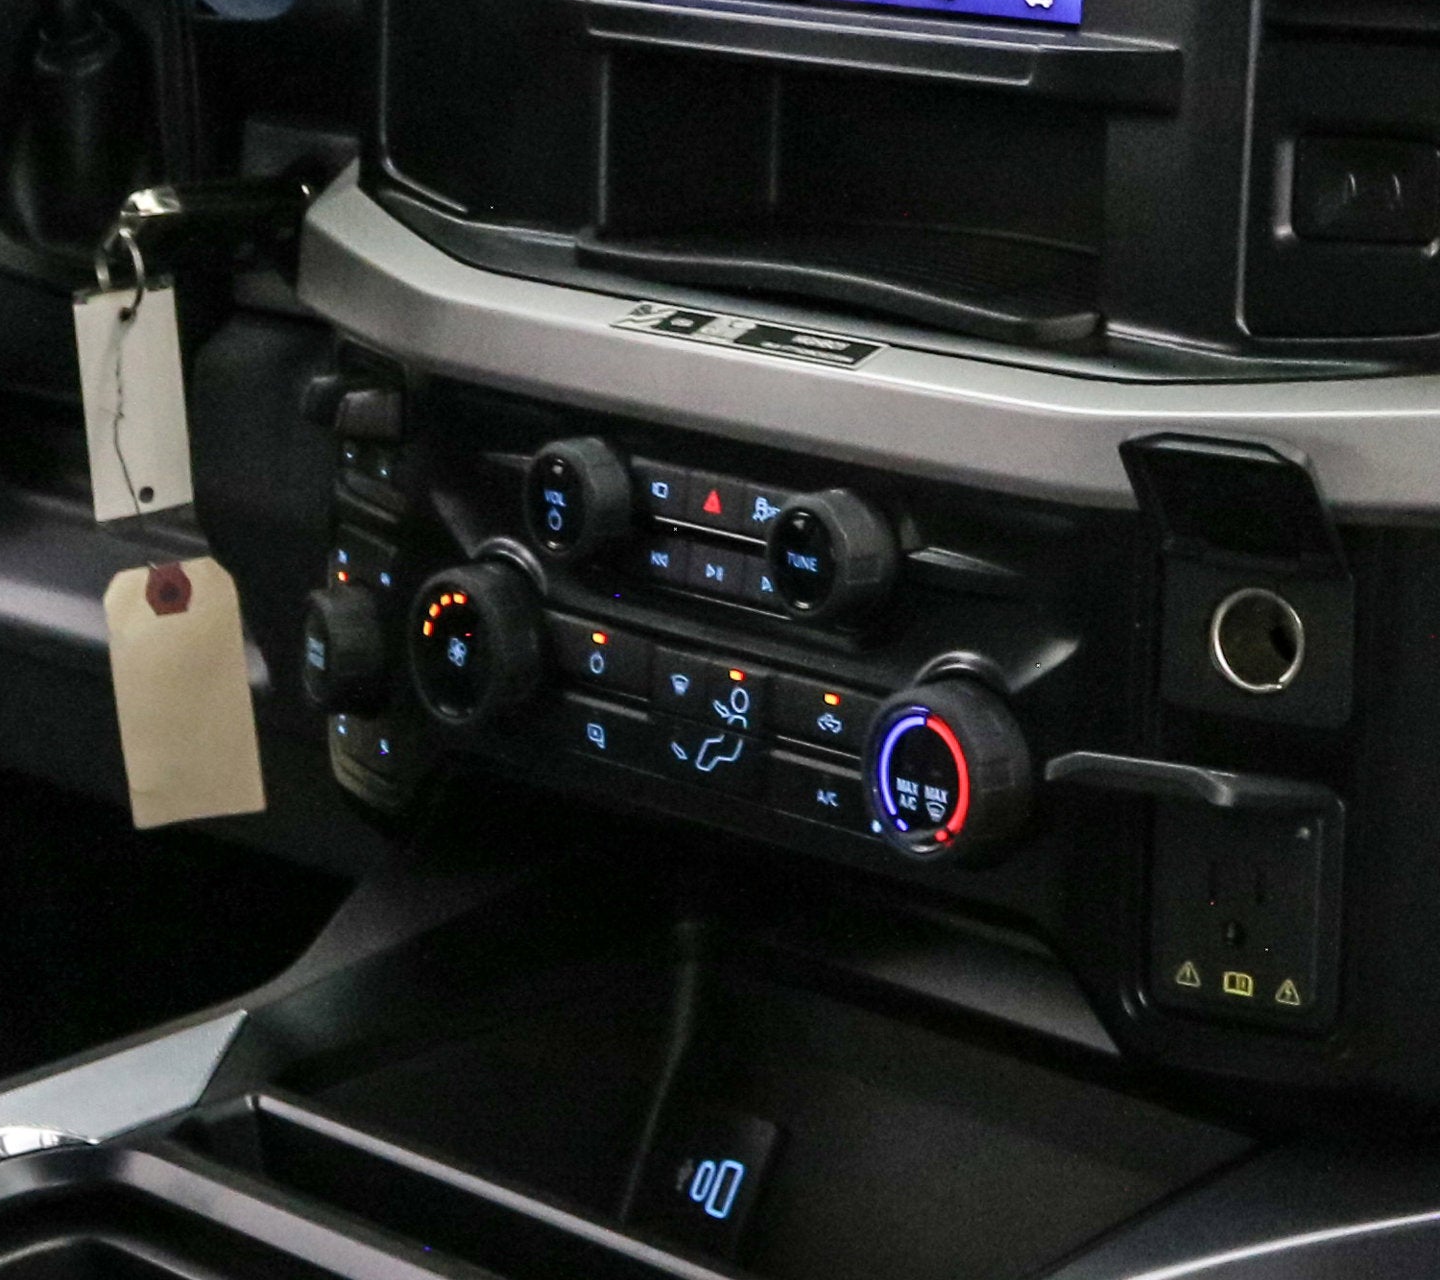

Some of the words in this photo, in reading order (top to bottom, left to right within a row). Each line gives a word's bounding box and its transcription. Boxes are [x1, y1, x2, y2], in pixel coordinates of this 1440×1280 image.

[544, 488, 567, 508] VOL
[786, 551, 818, 573] TUNE
[896, 777, 920, 798] MAX
[923, 784, 950, 805] MAX
